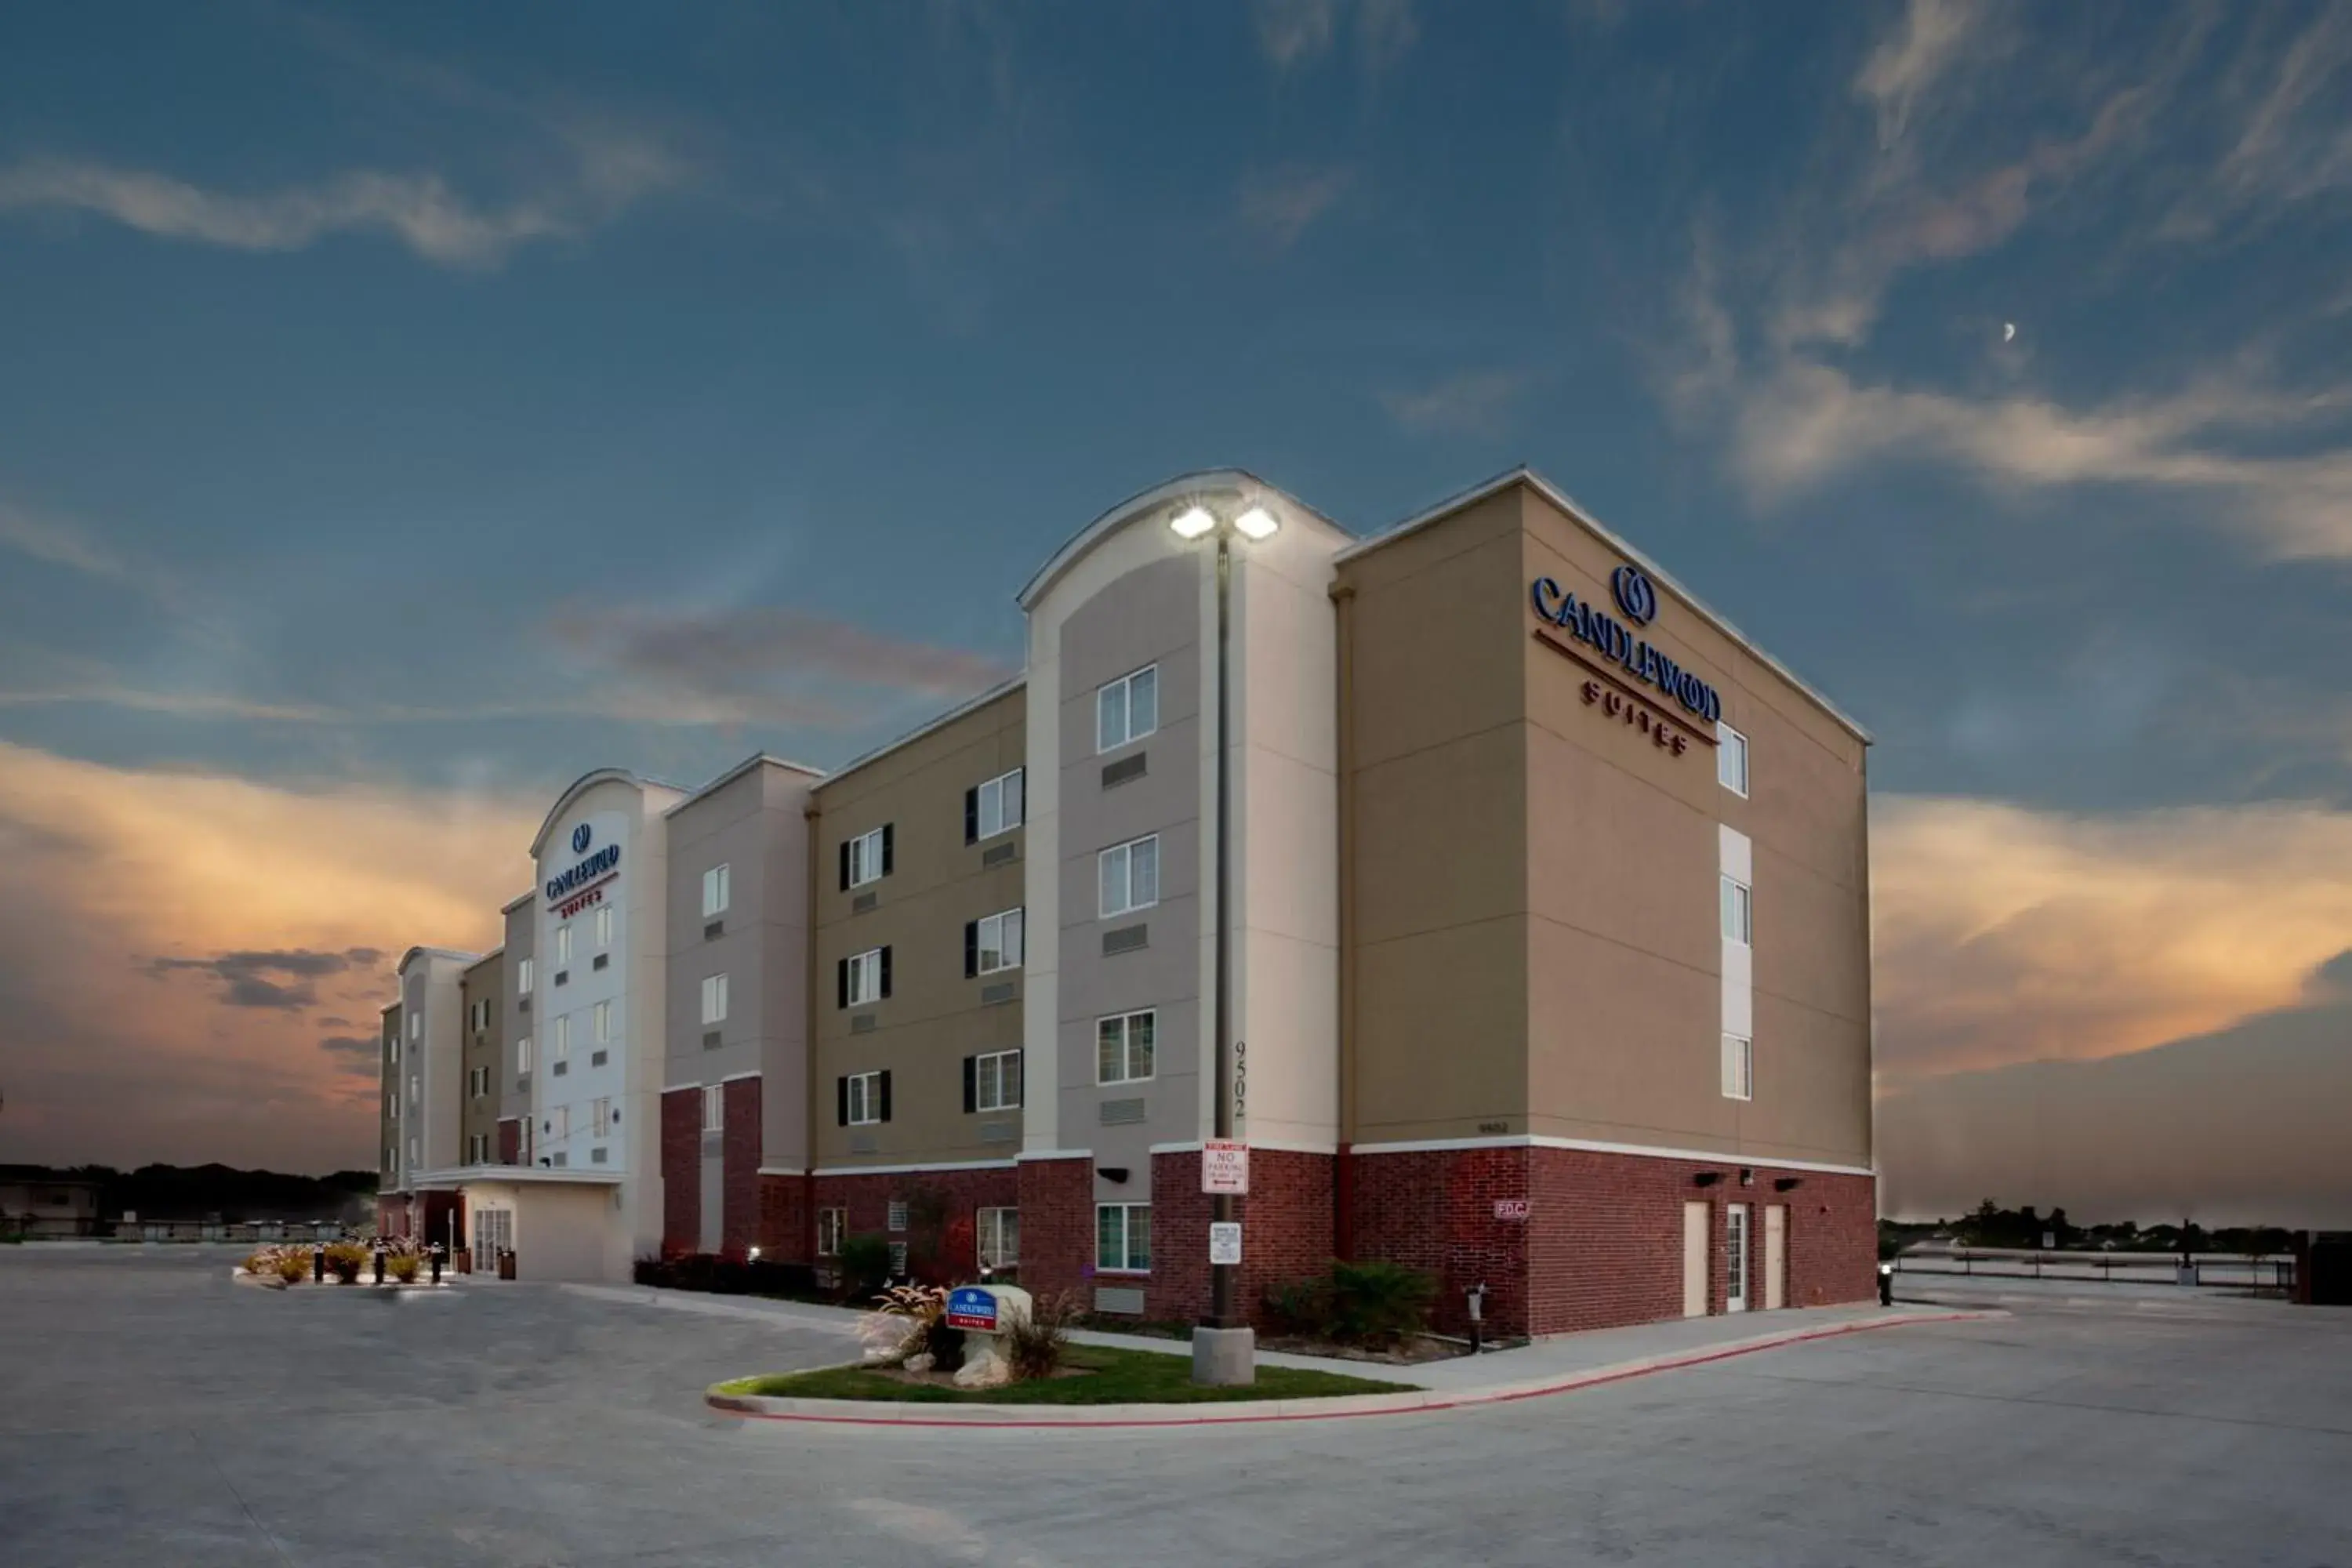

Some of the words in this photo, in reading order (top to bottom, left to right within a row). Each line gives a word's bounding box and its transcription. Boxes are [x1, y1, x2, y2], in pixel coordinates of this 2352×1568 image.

[1533, 577, 1722, 722] CANDLEWOOD
[1581, 680, 1687, 756] SUITES
[546, 844, 619, 901] CANDLEWOOD
[561, 890, 602, 920] SUITES
[1234, 1040, 1246, 1117] 9502
[1216, 1152, 1235, 1162] NO
[949, 1304, 994, 1316] CANDLEWOOD
